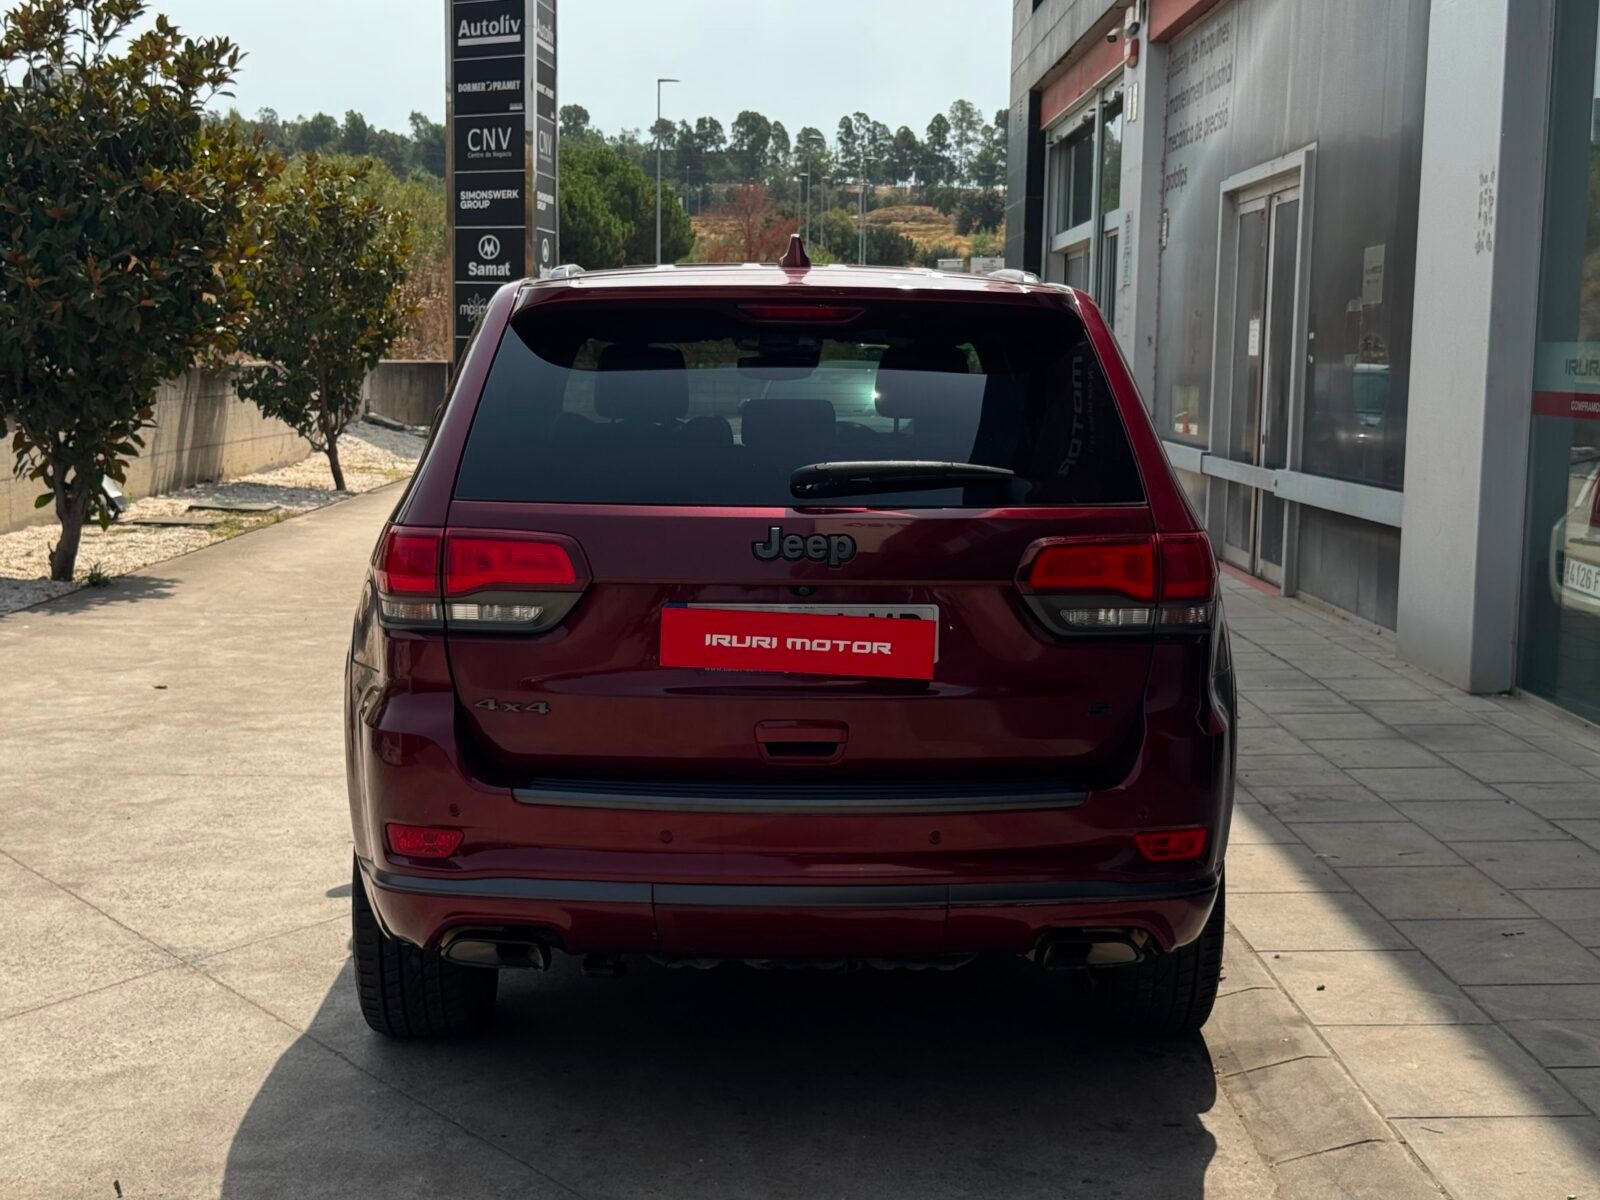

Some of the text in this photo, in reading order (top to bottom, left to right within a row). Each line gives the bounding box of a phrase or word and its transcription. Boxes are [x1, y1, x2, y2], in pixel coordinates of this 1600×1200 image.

[458, 80, 521, 93] DORMER PRAMET
[467, 127, 512, 152] CNV
[460, 189, 519, 200] SIMONSWERK
[460, 200, 490, 210] GROUP
[468, 261, 511, 276] Samat
[752, 526, 857, 567] Jeep
[705, 633, 892, 655] IRURI MOTOR
[474, 698, 551, 715] 4x4
